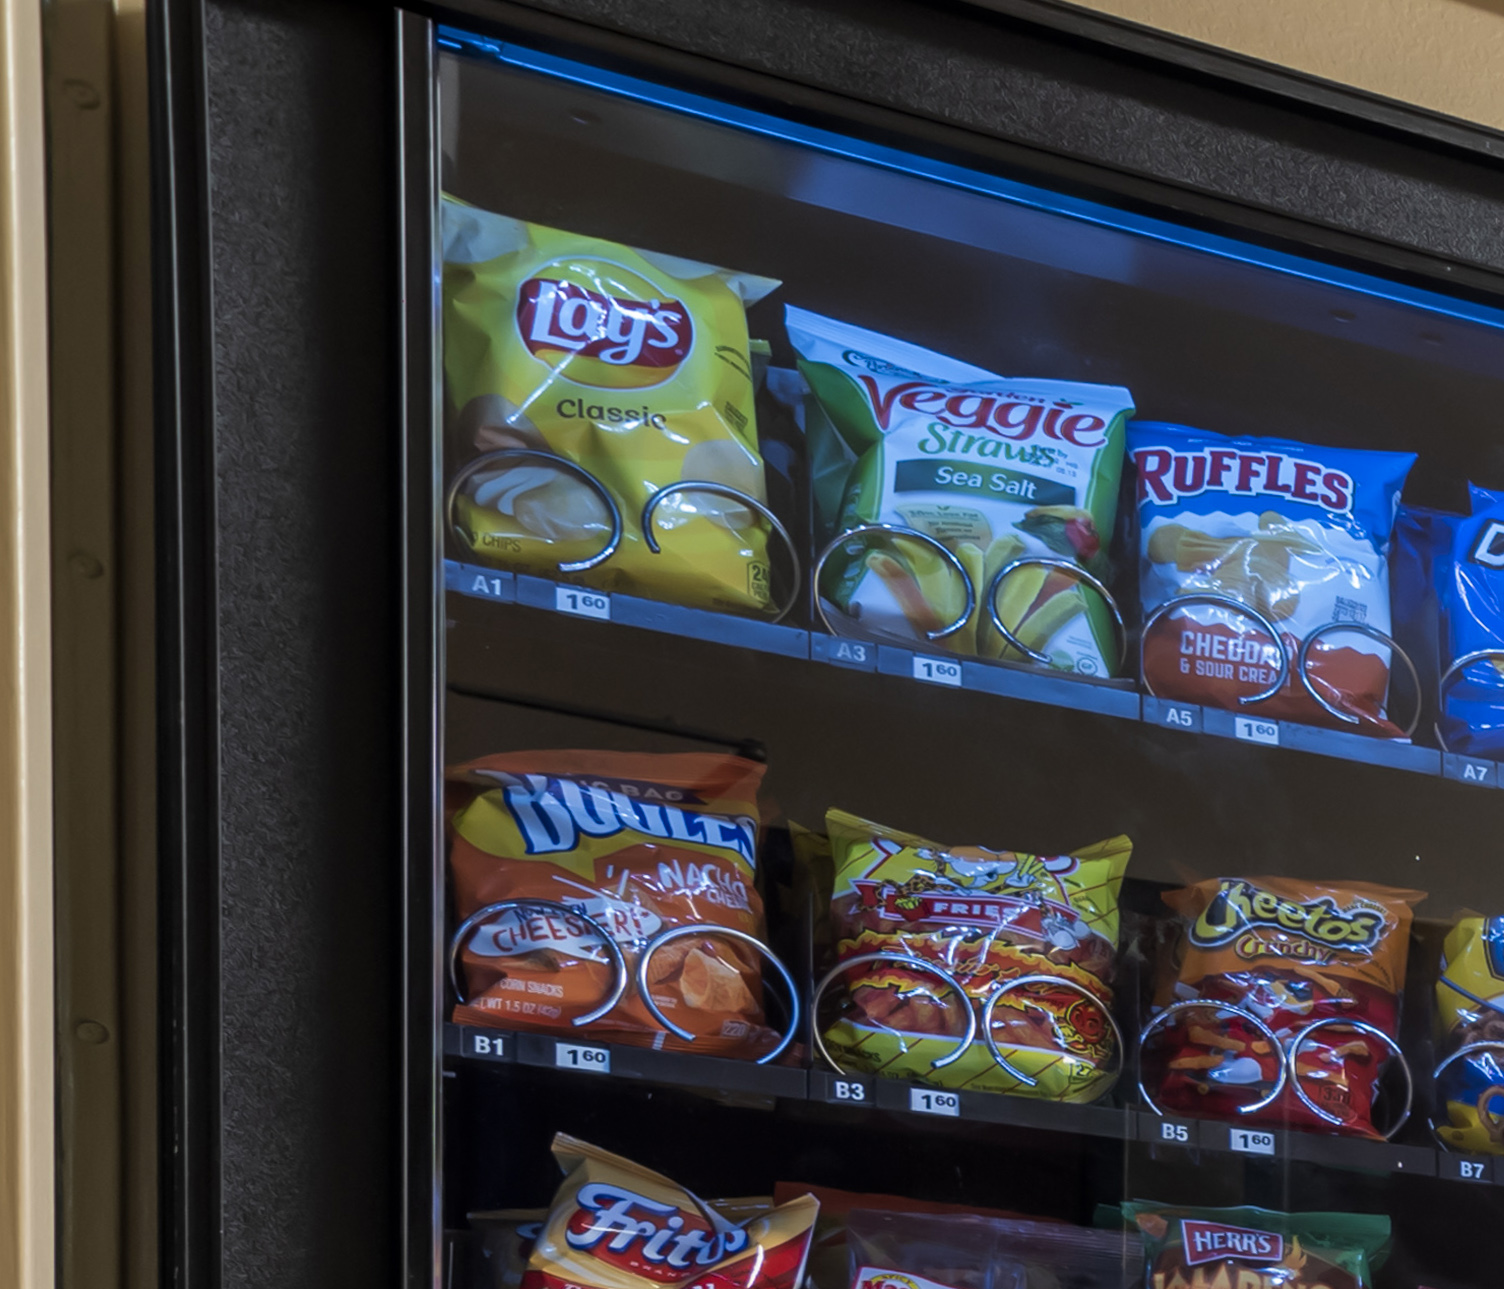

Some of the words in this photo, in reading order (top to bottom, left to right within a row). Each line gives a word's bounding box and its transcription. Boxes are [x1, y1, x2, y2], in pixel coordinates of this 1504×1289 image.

[530, 278, 685, 366] Lay's
[556, 398, 668, 430] Classic
[858, 374, 1108, 449] Veggie
[918, 422, 1055, 467] Straws
[935, 466, 982, 490] Sea
[988, 471, 1037, 499] Salt
[1134, 447, 1354, 513] RUFFLES
[472, 576, 502, 597] A1
[837, 643, 867, 663] A3
[1195, 660, 1233, 680] SOUR
[1167, 710, 1193, 727] A5
[1463, 763, 1488, 781] A7
[934, 901, 1018, 918] FRIES
[1190, 879, 1383, 946] Cheetos
[1236, 934, 1334, 964] Crunchy
[474, 1035, 504, 1056] B1
[835, 1080, 865, 1100] B3
[1162, 1122, 1189, 1142] B5
[1460, 1161, 1485, 1178] B7
[1193, 1229, 1272, 1255] HERR'S
